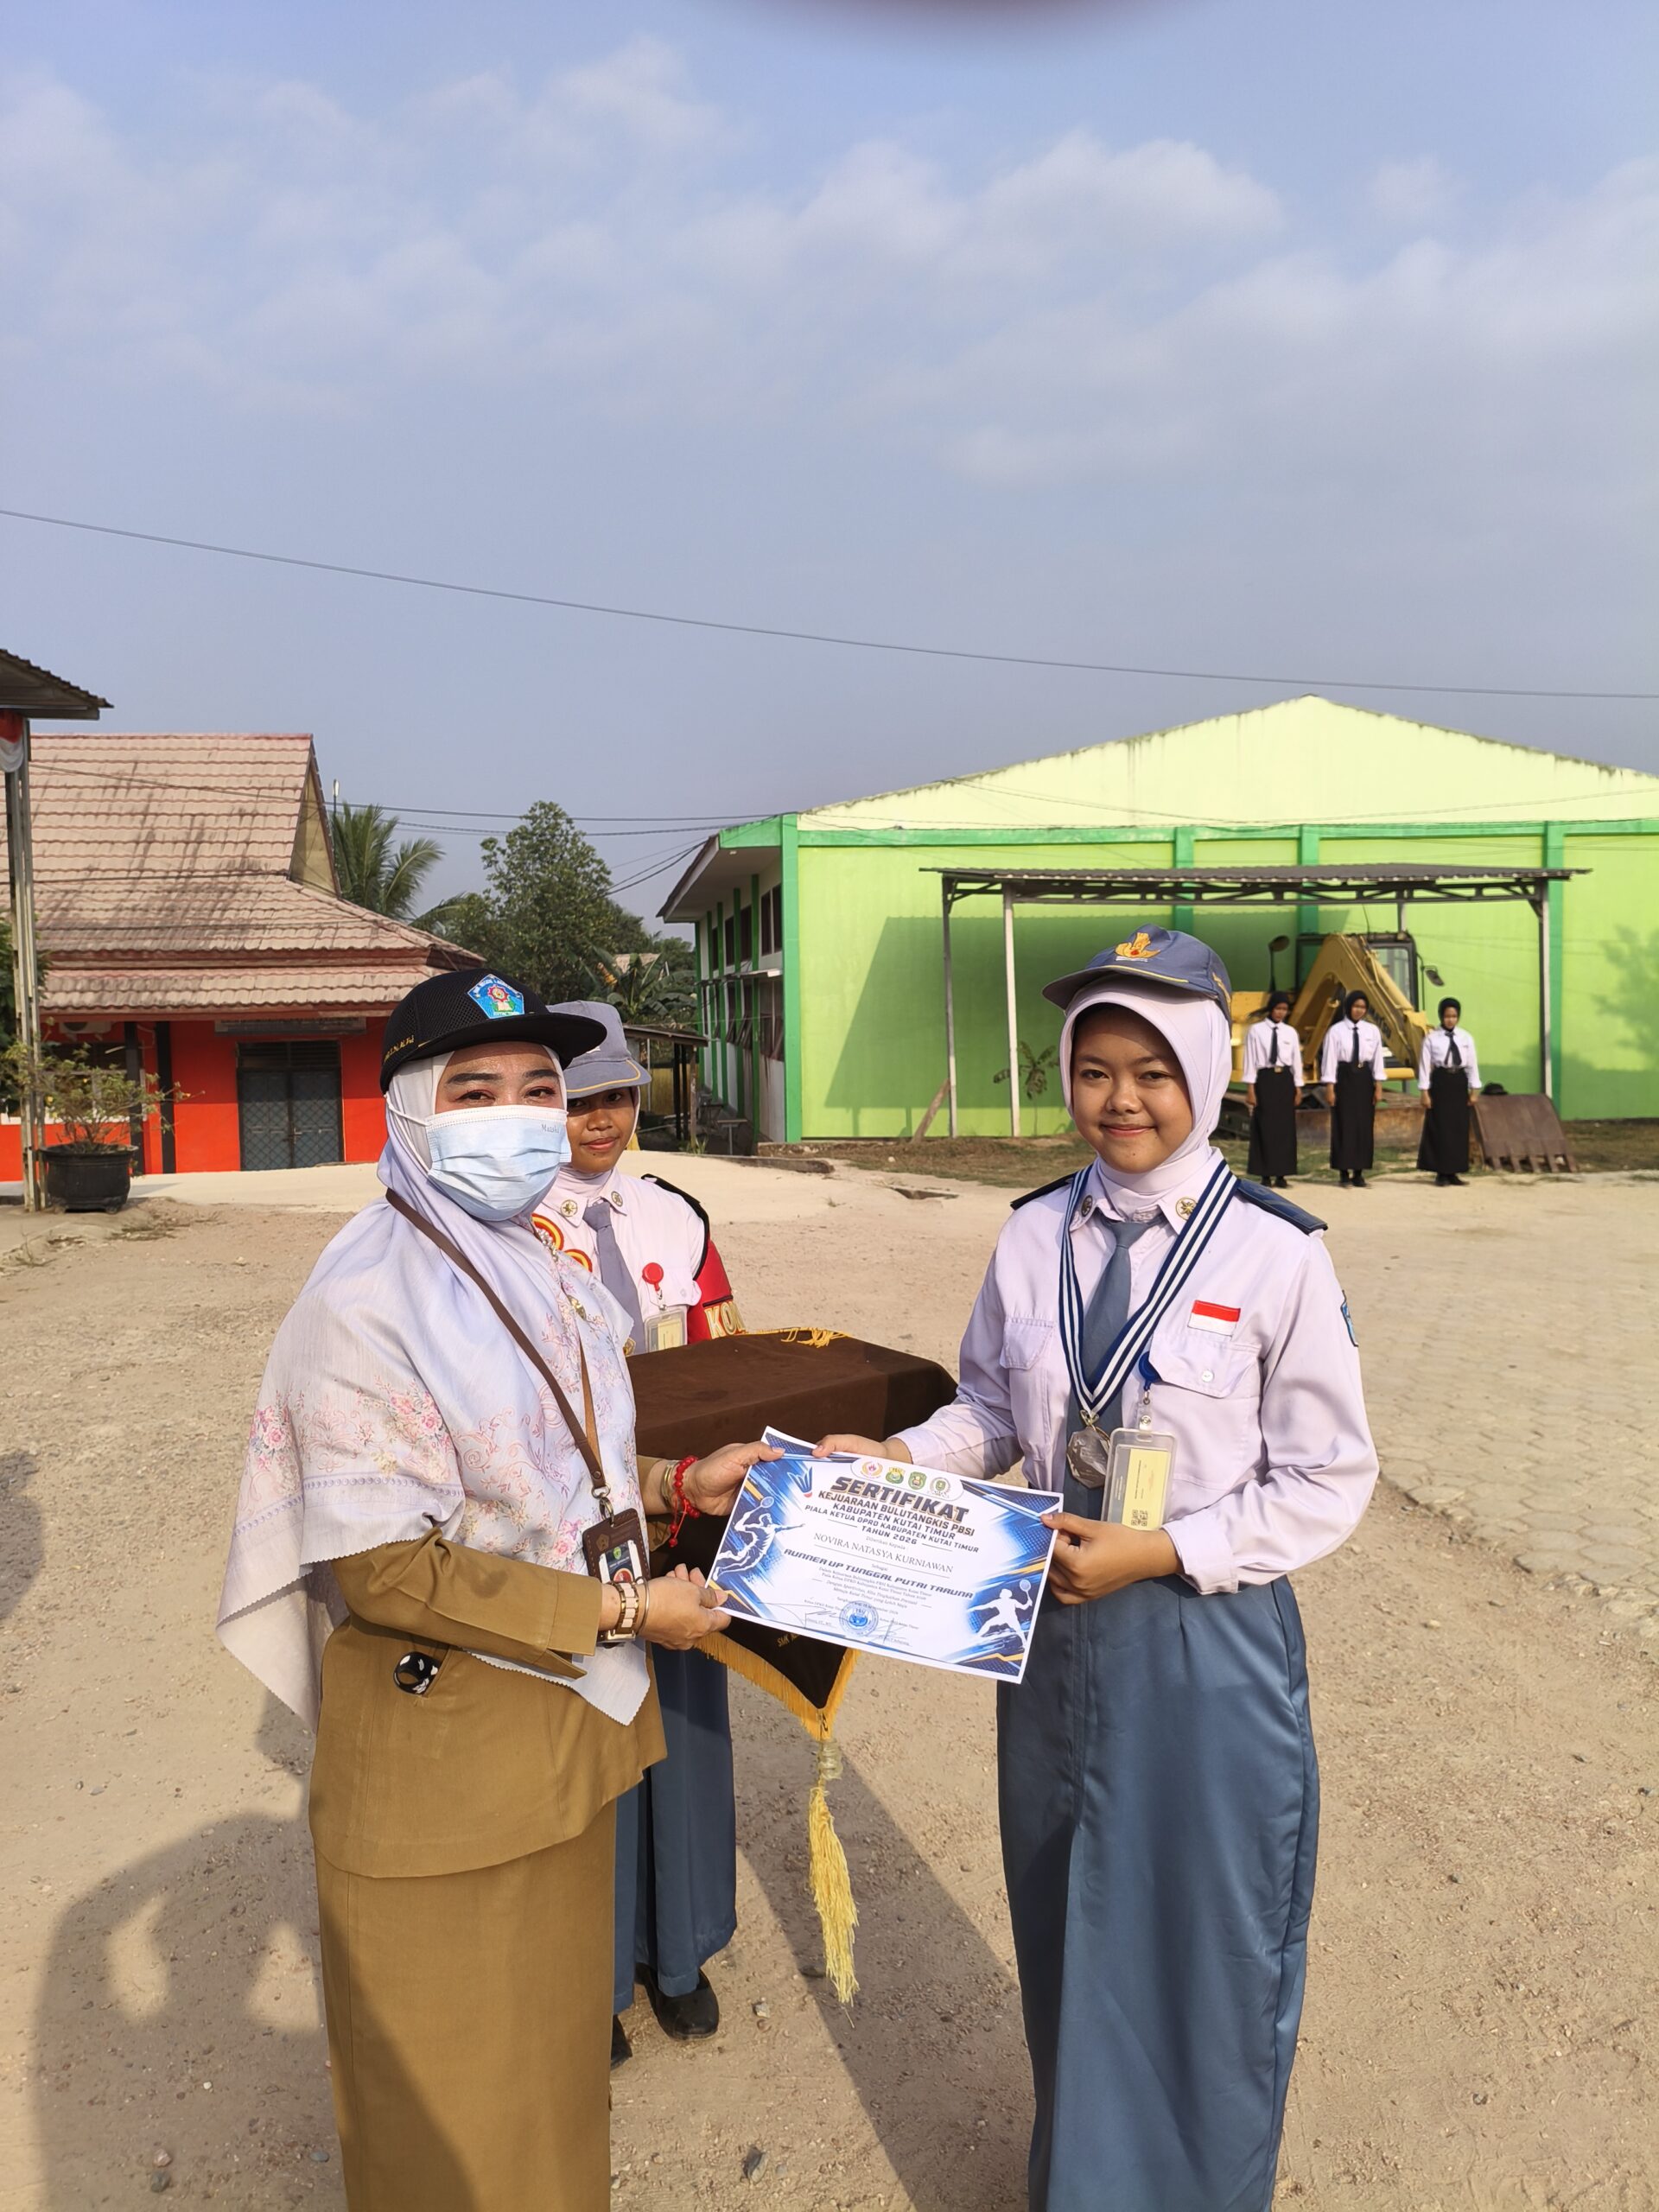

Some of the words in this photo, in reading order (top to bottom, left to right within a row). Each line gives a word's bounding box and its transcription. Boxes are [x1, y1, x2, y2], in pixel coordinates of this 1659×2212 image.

[818, 1491, 879, 1510] KEJUARAAN
[880, 1505, 949, 1529] BULUTANGKIS
[951, 1523, 975, 1536] PBSI
[830, 1476, 969, 1523] SERTIFIKAT
[833, 1503, 892, 1523] KABUPATEN
[893, 1516, 923, 1530] KUTAI
[925, 1525, 956, 1540] TIMUR
[805, 1505, 828, 1515] PIALA
[830, 1510, 855, 1522] KETUA
[857, 1516, 878, 1527] DPRD
[880, 1522, 926, 1540] KABUPATEN
[929, 1535, 952, 1547] KUTAI
[954, 1542, 979, 1553] TIMUR
[861, 1526, 890, 1538] TAHUN
[893, 1534, 918, 1545] 2026
[784, 1548, 828, 1566] RUNNER
[845, 1565, 893, 1581] TUNGGAL
[894, 1577, 927, 1589] PUTRI
[930, 1585, 974, 1599] TARUNA
[814, 1532, 850, 1548] NOVIRA
[851, 1542, 893, 1560] NATASYA
[895, 1550, 954, 1573] KURNIAWAN
